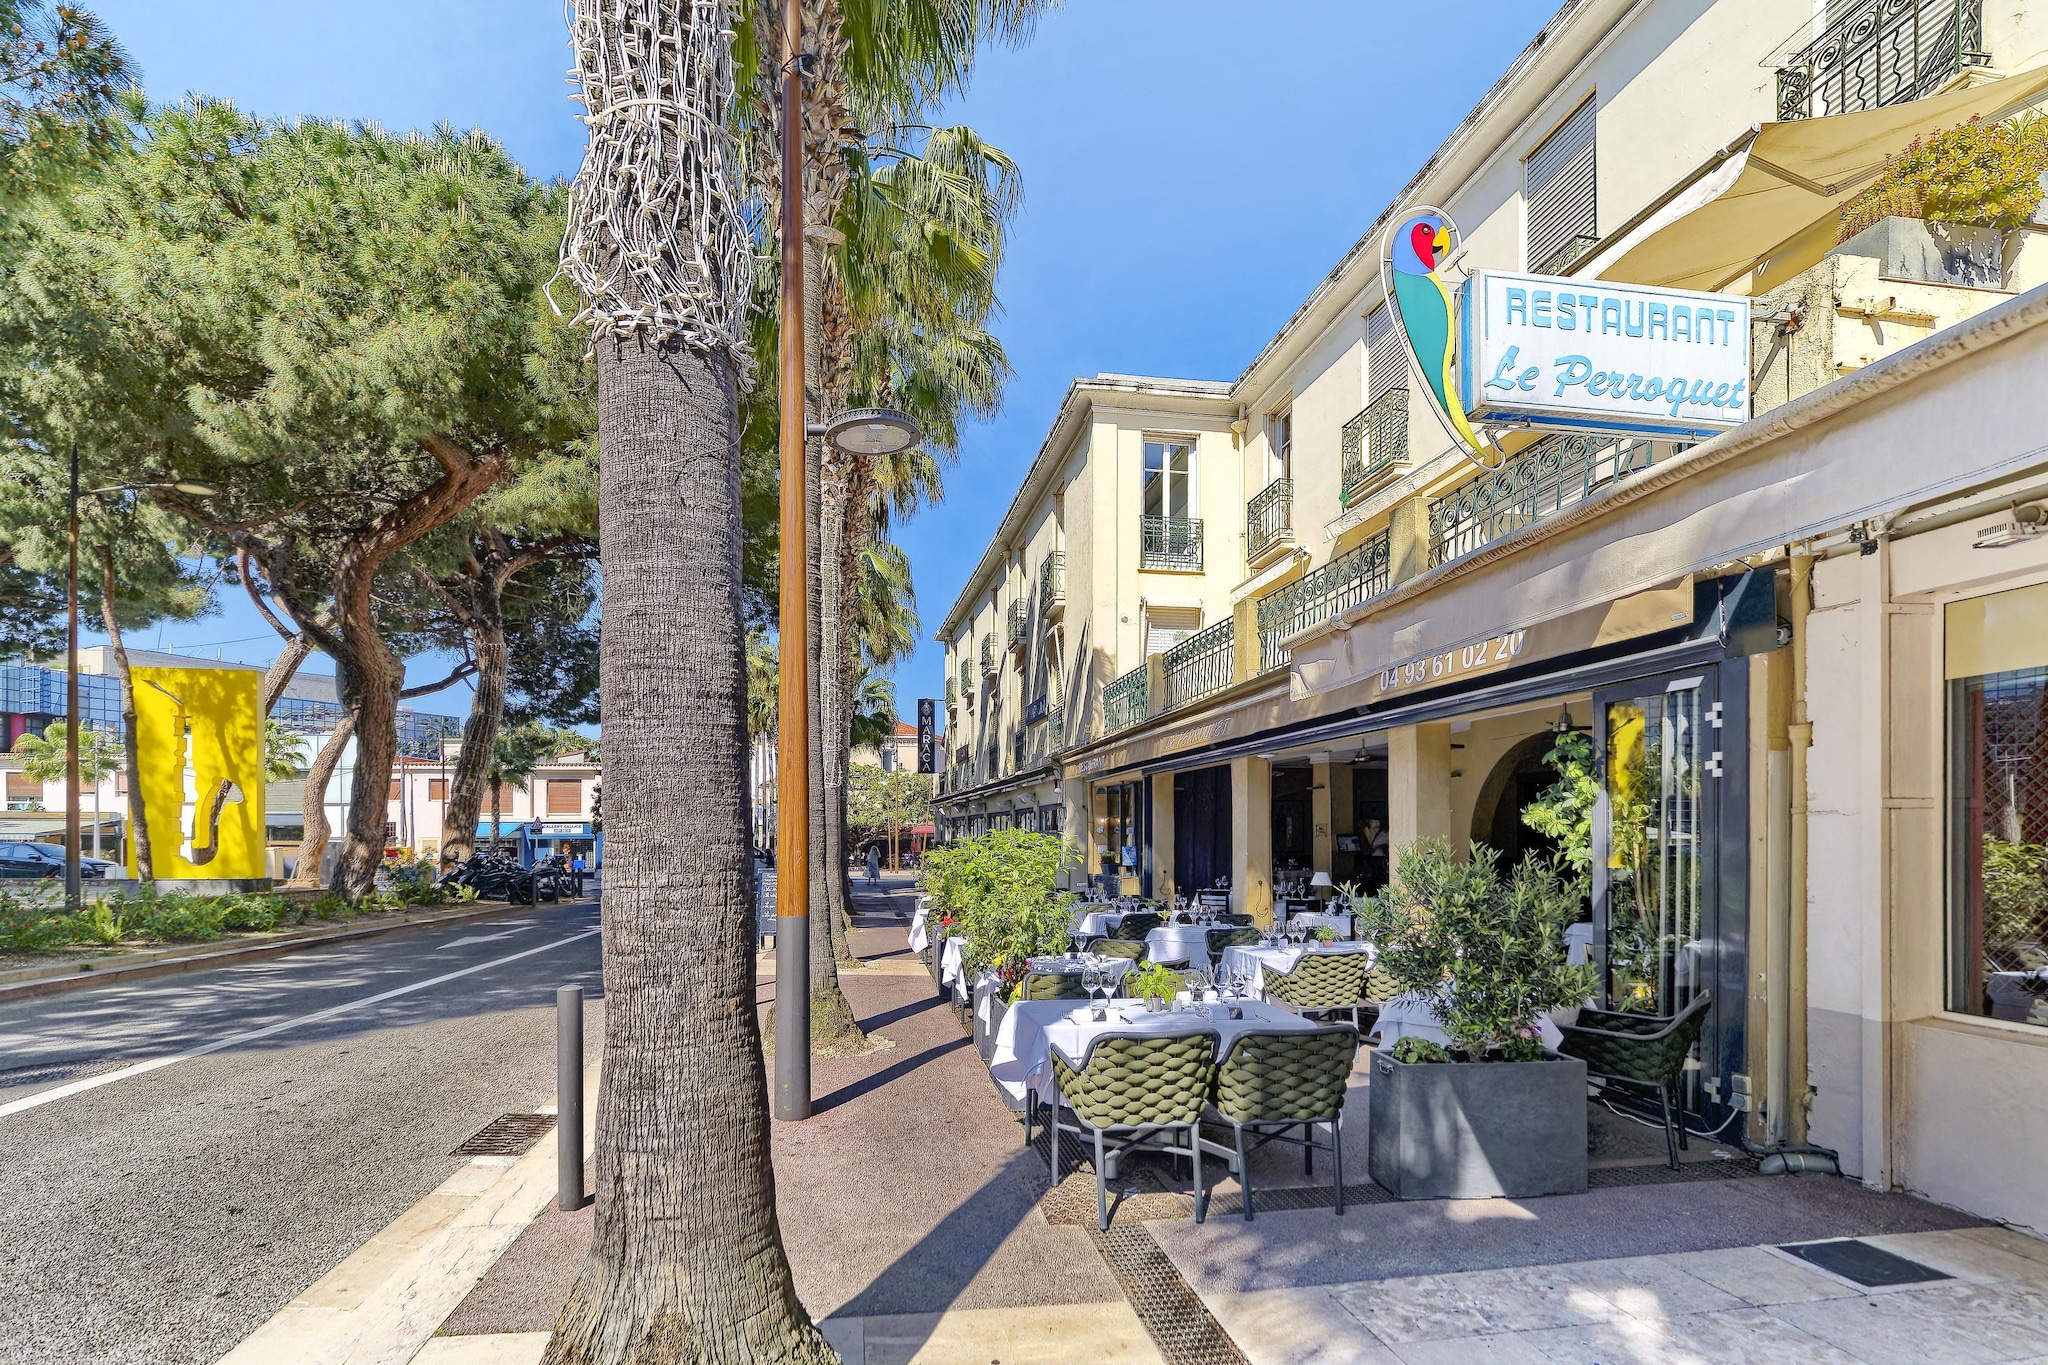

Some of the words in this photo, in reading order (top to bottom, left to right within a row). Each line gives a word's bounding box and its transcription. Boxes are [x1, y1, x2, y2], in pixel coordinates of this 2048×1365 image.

[1506, 287, 1735, 346] RESTAURANT
[1484, 345, 1541, 391] Le
[1553, 353, 1746, 418] Perroquet
[1379, 667, 1399, 691] 04
[1404, 660, 1426, 684] 93
[1432, 652, 1453, 677] 61
[1461, 642, 1489, 669] 02
[1494, 629, 1524, 660] 20
[921, 716, 931, 771] MARACA
